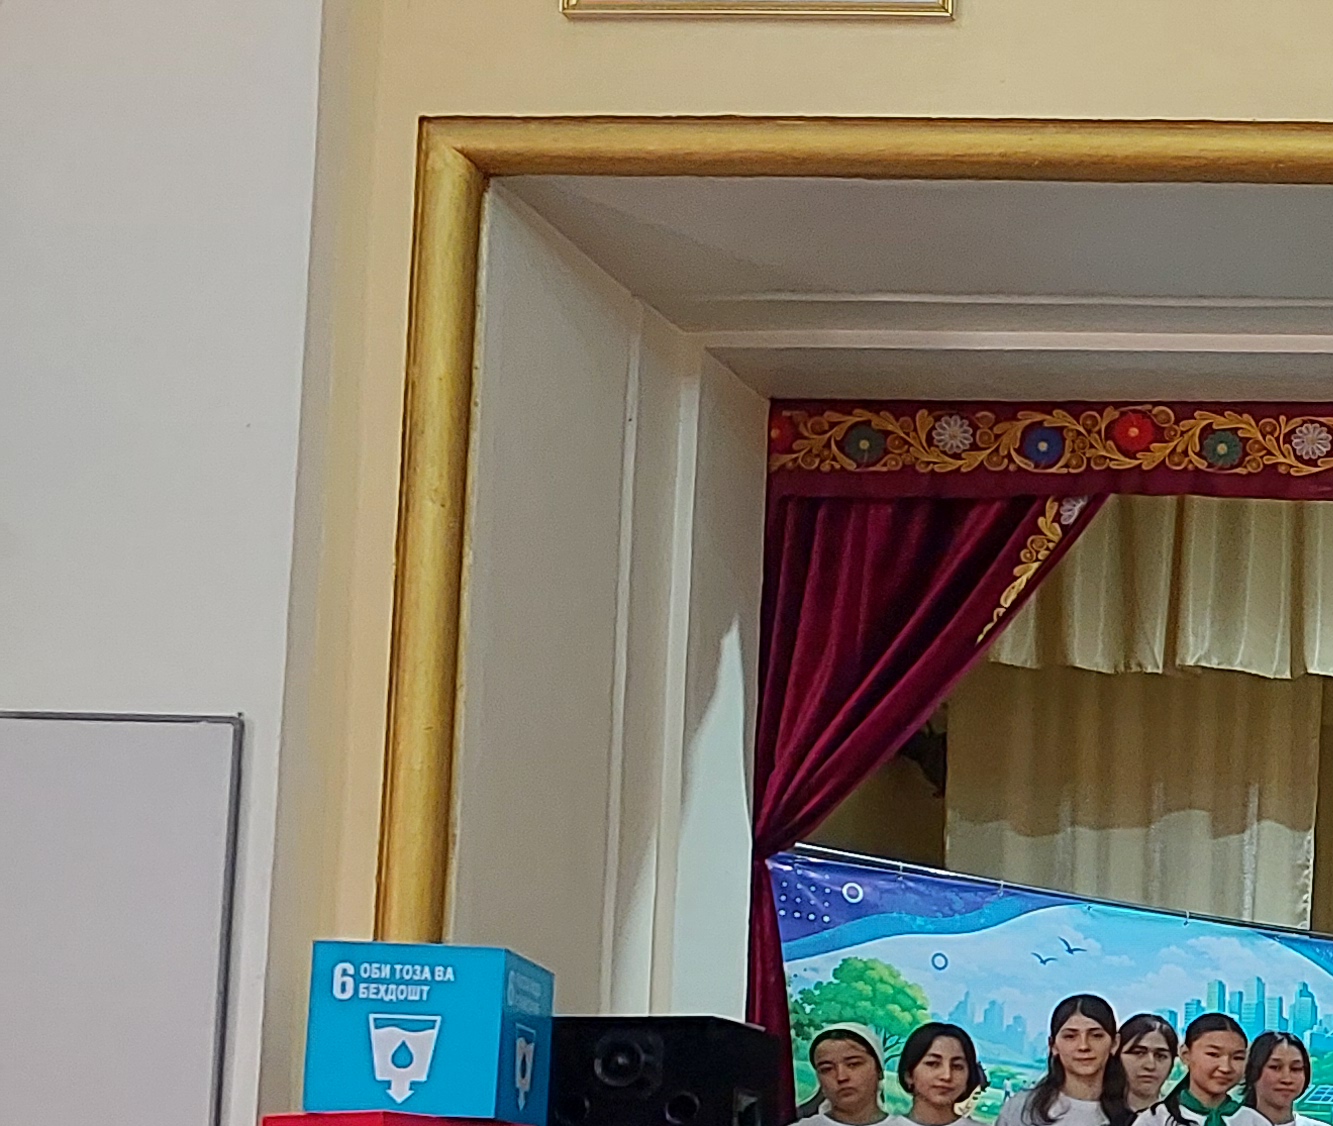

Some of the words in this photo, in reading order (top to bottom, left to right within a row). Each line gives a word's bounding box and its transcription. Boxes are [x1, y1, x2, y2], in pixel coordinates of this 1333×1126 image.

[333, 962, 354, 1001] 6
[360, 963, 391, 981] ОБИ
[394, 965, 431, 982] ТОЗА
[435, 966, 455, 983] ВА
